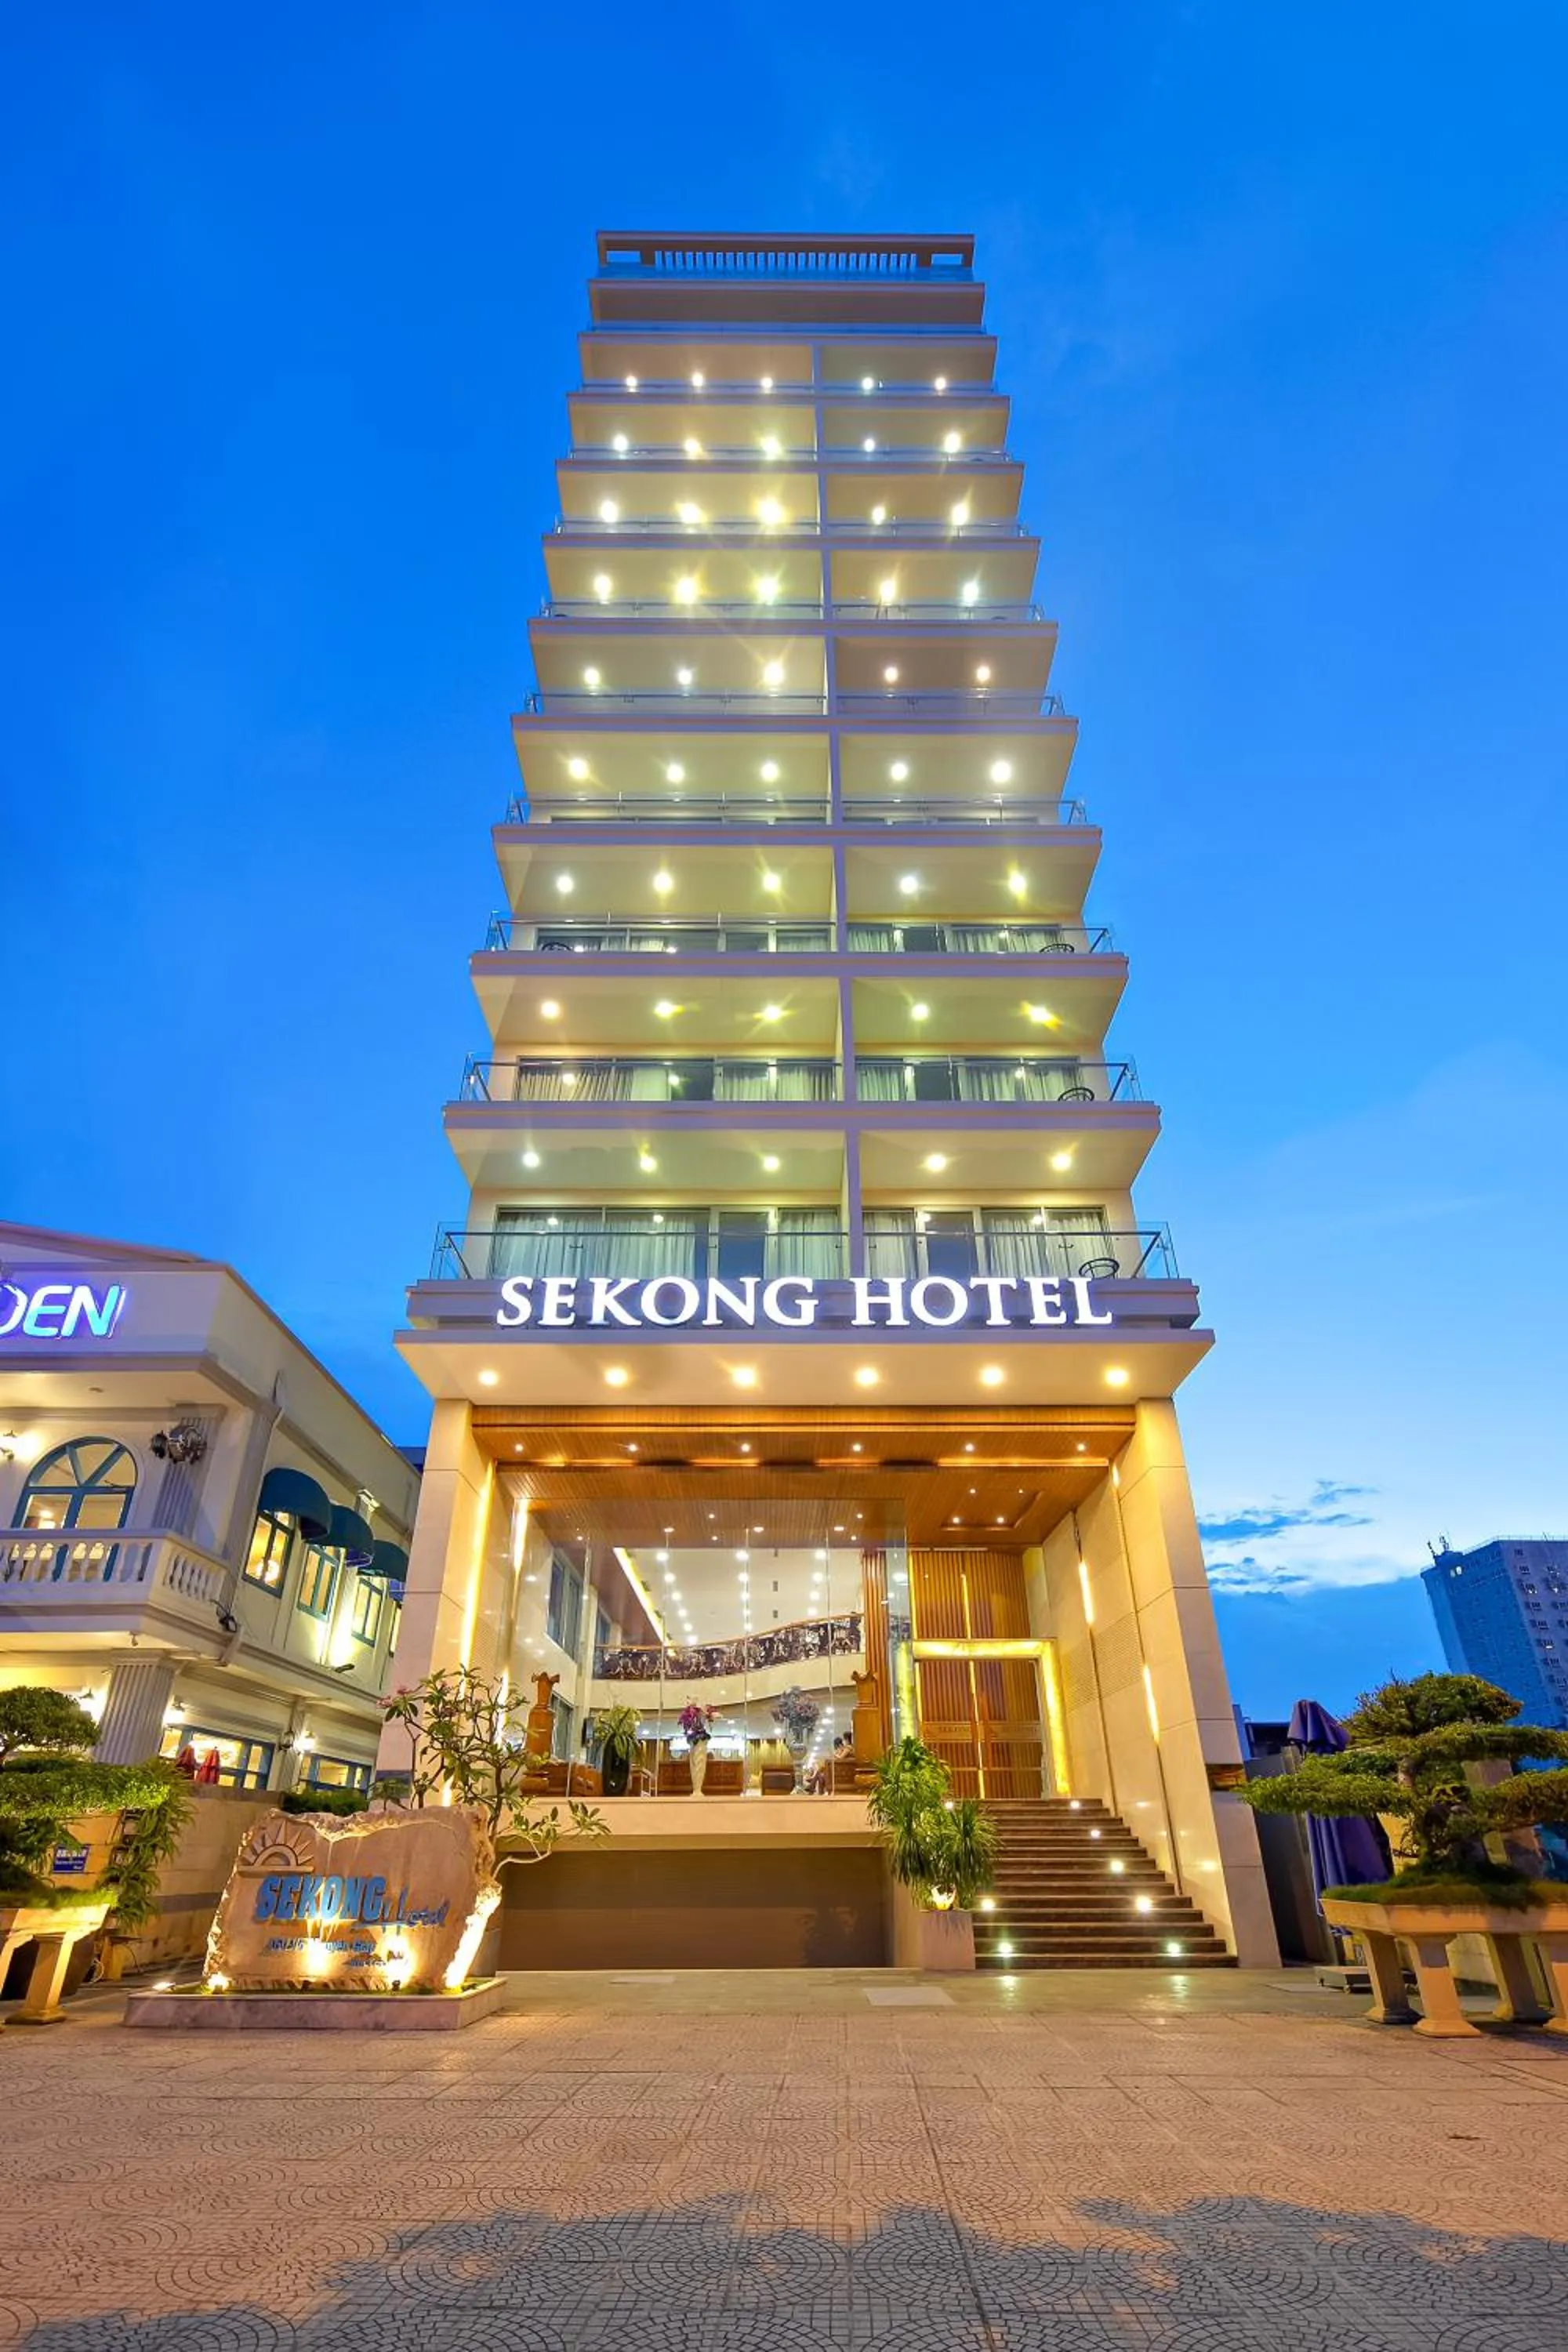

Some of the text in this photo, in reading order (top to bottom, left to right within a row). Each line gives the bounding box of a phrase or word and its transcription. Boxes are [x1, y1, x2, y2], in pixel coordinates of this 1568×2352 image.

[495, 1276, 1112, 1326] SEKONG HOTEL
[254, 1875, 387, 1921] SEKONG
